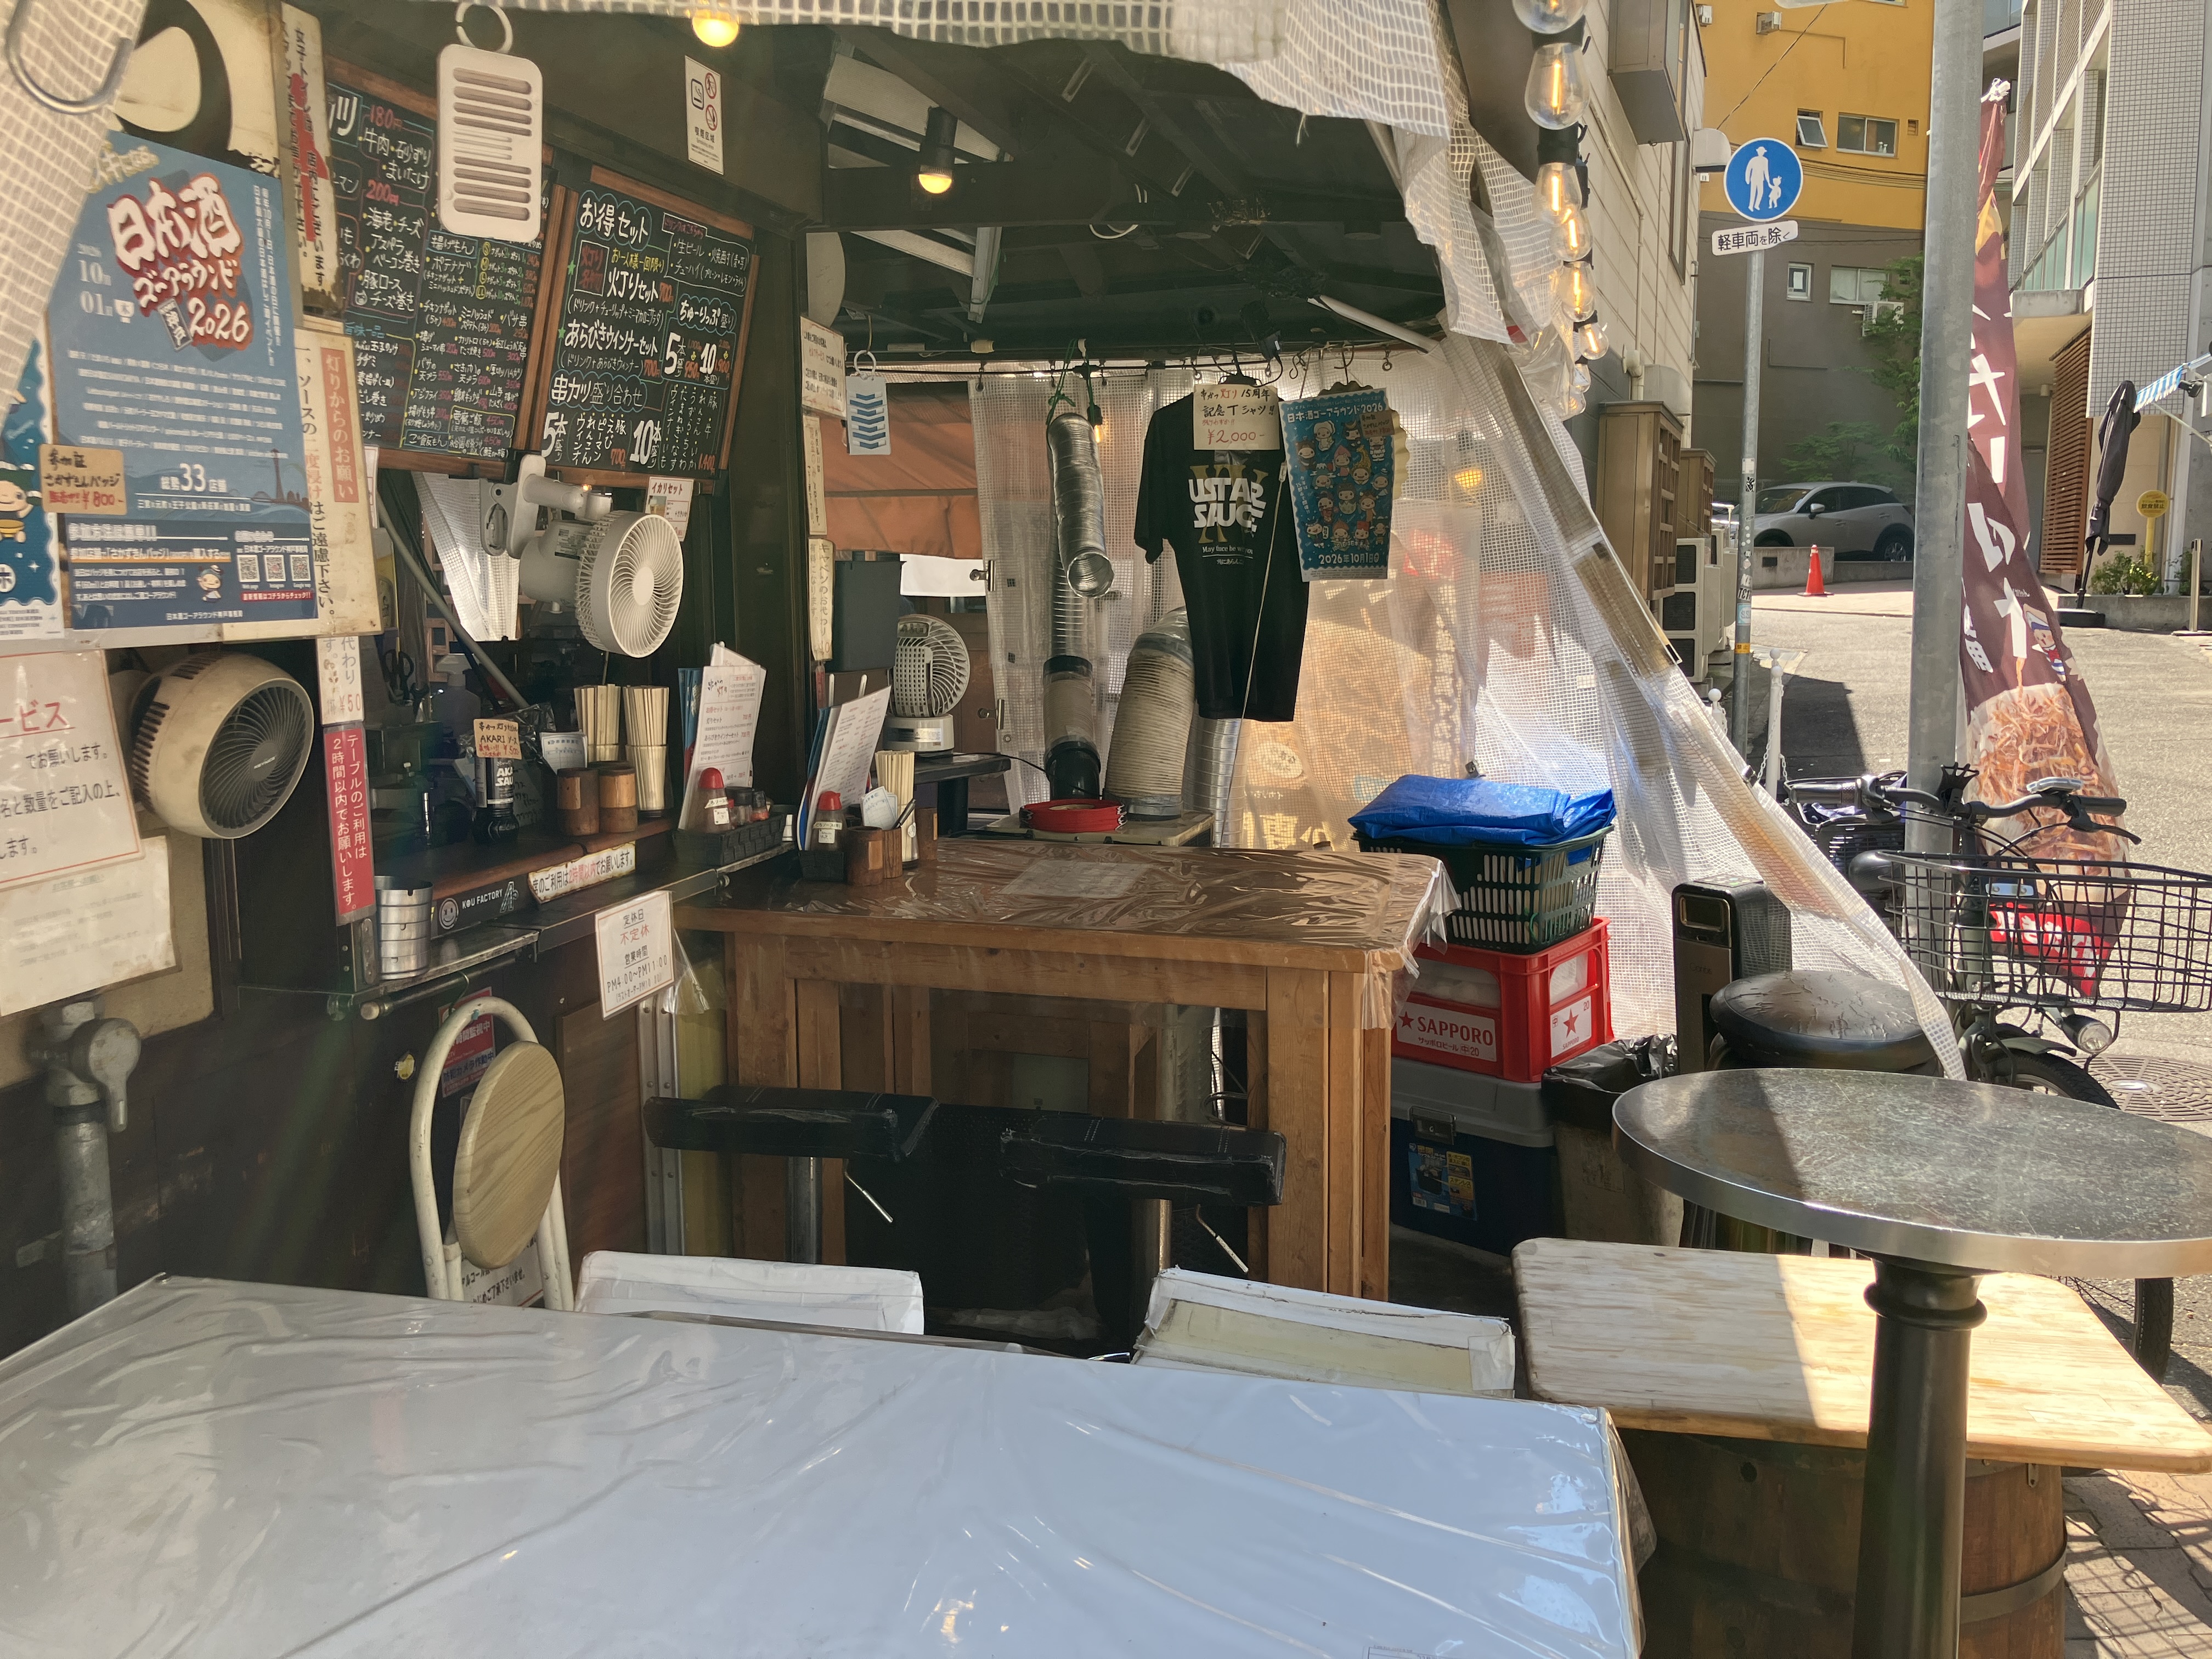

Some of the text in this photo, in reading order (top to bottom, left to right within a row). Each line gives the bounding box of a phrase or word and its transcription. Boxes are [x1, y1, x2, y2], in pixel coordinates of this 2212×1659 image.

[364, 127, 390, 156] 牛肉
[580, 198, 648, 245] お得セット
[676, 238, 704, 257] 生ビール
[1718, 227, 1790, 251] 軽車両を除く
[607, 267, 658, 303] 灯りセット
[187, 296, 251, 343] 2026
[551, 374, 643, 407] 串カツ盛り合わせ
[1287, 402, 1384, 423] 日本酒ゴーアラウンド2026
[325, 354, 354, 499] 灯りからのお願い
[652, 482, 683, 495] イカリセット
[347, 735, 367, 859] テーブルのご利用は
[331, 738, 357, 910] 2時間以内でお願いします。
[476, 889, 503, 906] FACTORY
[623, 909, 644, 926] 定休日
[620, 924, 650, 945] 不定休
[624, 945, 648, 965] 営業時間
[1583, 1000, 1590, 1012] 20
[1417, 1016, 1493, 1046] SAPPORO
[1418, 1036, 1459, 1052] サッポロビール
[1562, 1036, 1579, 1050] SAPPORO
